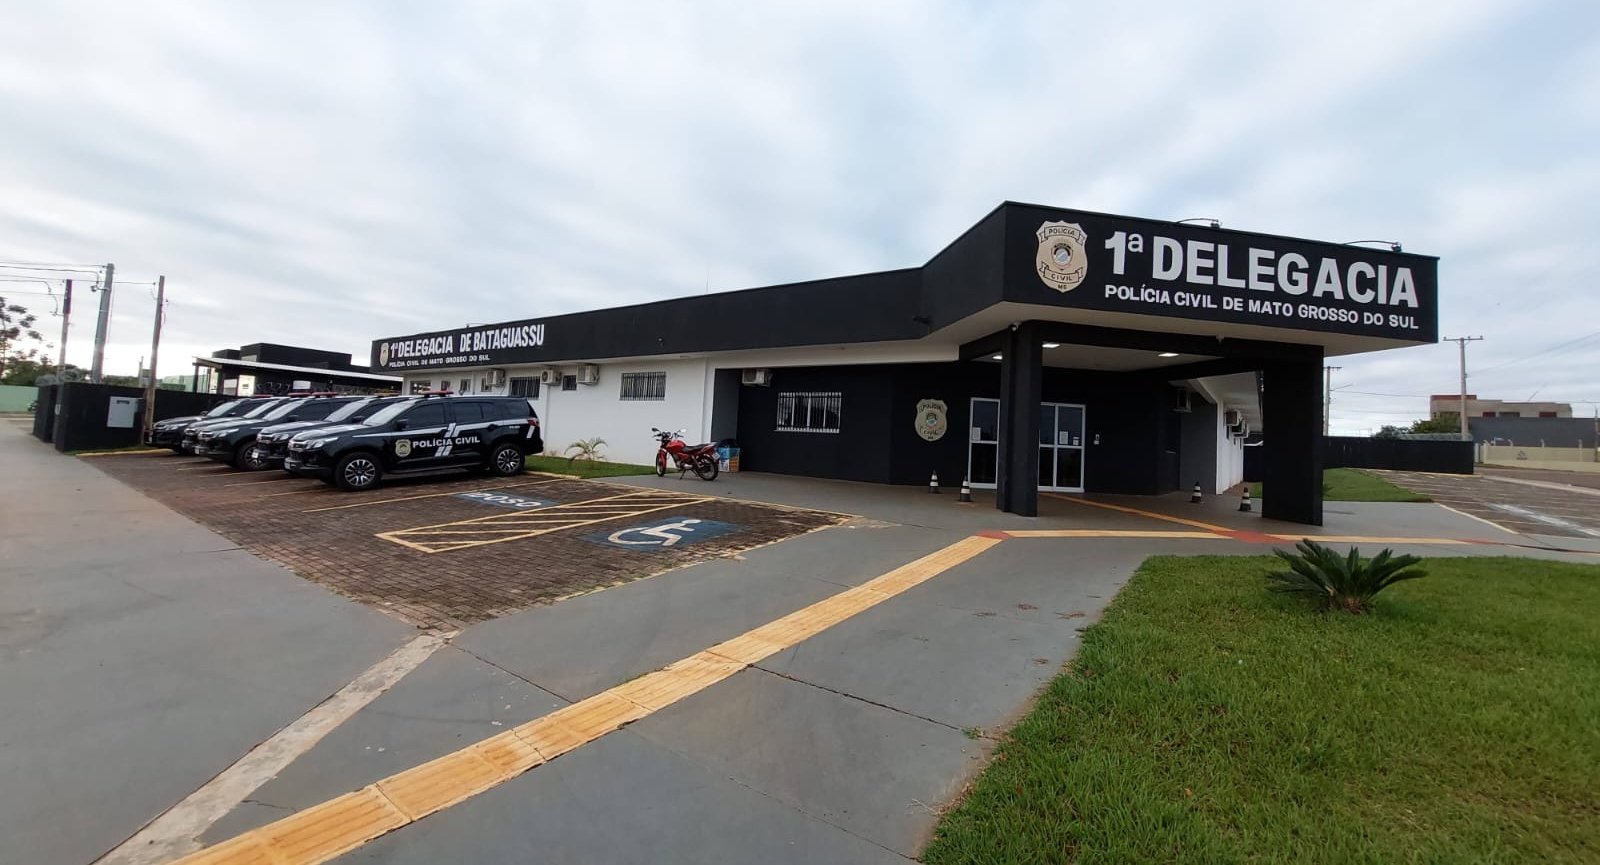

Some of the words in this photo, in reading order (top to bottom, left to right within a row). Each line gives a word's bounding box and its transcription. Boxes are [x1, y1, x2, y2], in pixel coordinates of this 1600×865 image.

[1051, 273, 1073, 282] CIVIL
[1152, 235, 1419, 308] DELEGACIA
[1104, 283, 1171, 305] POLÍCIA
[1174, 291, 1218, 309] CIVIL
[1222, 296, 1244, 312] DE
[1248, 299, 1293, 317] MATO
[1298, 304, 1359, 324] GROSSO
[1363, 312, 1384, 326] DO
[1388, 314, 1419, 330] SUL
[398, 335, 453, 358] DELEGACIA
[460, 333, 472, 353] DE
[473, 323, 545, 350] BATAGUASSU
[455, 436, 480, 445] CIVIL
